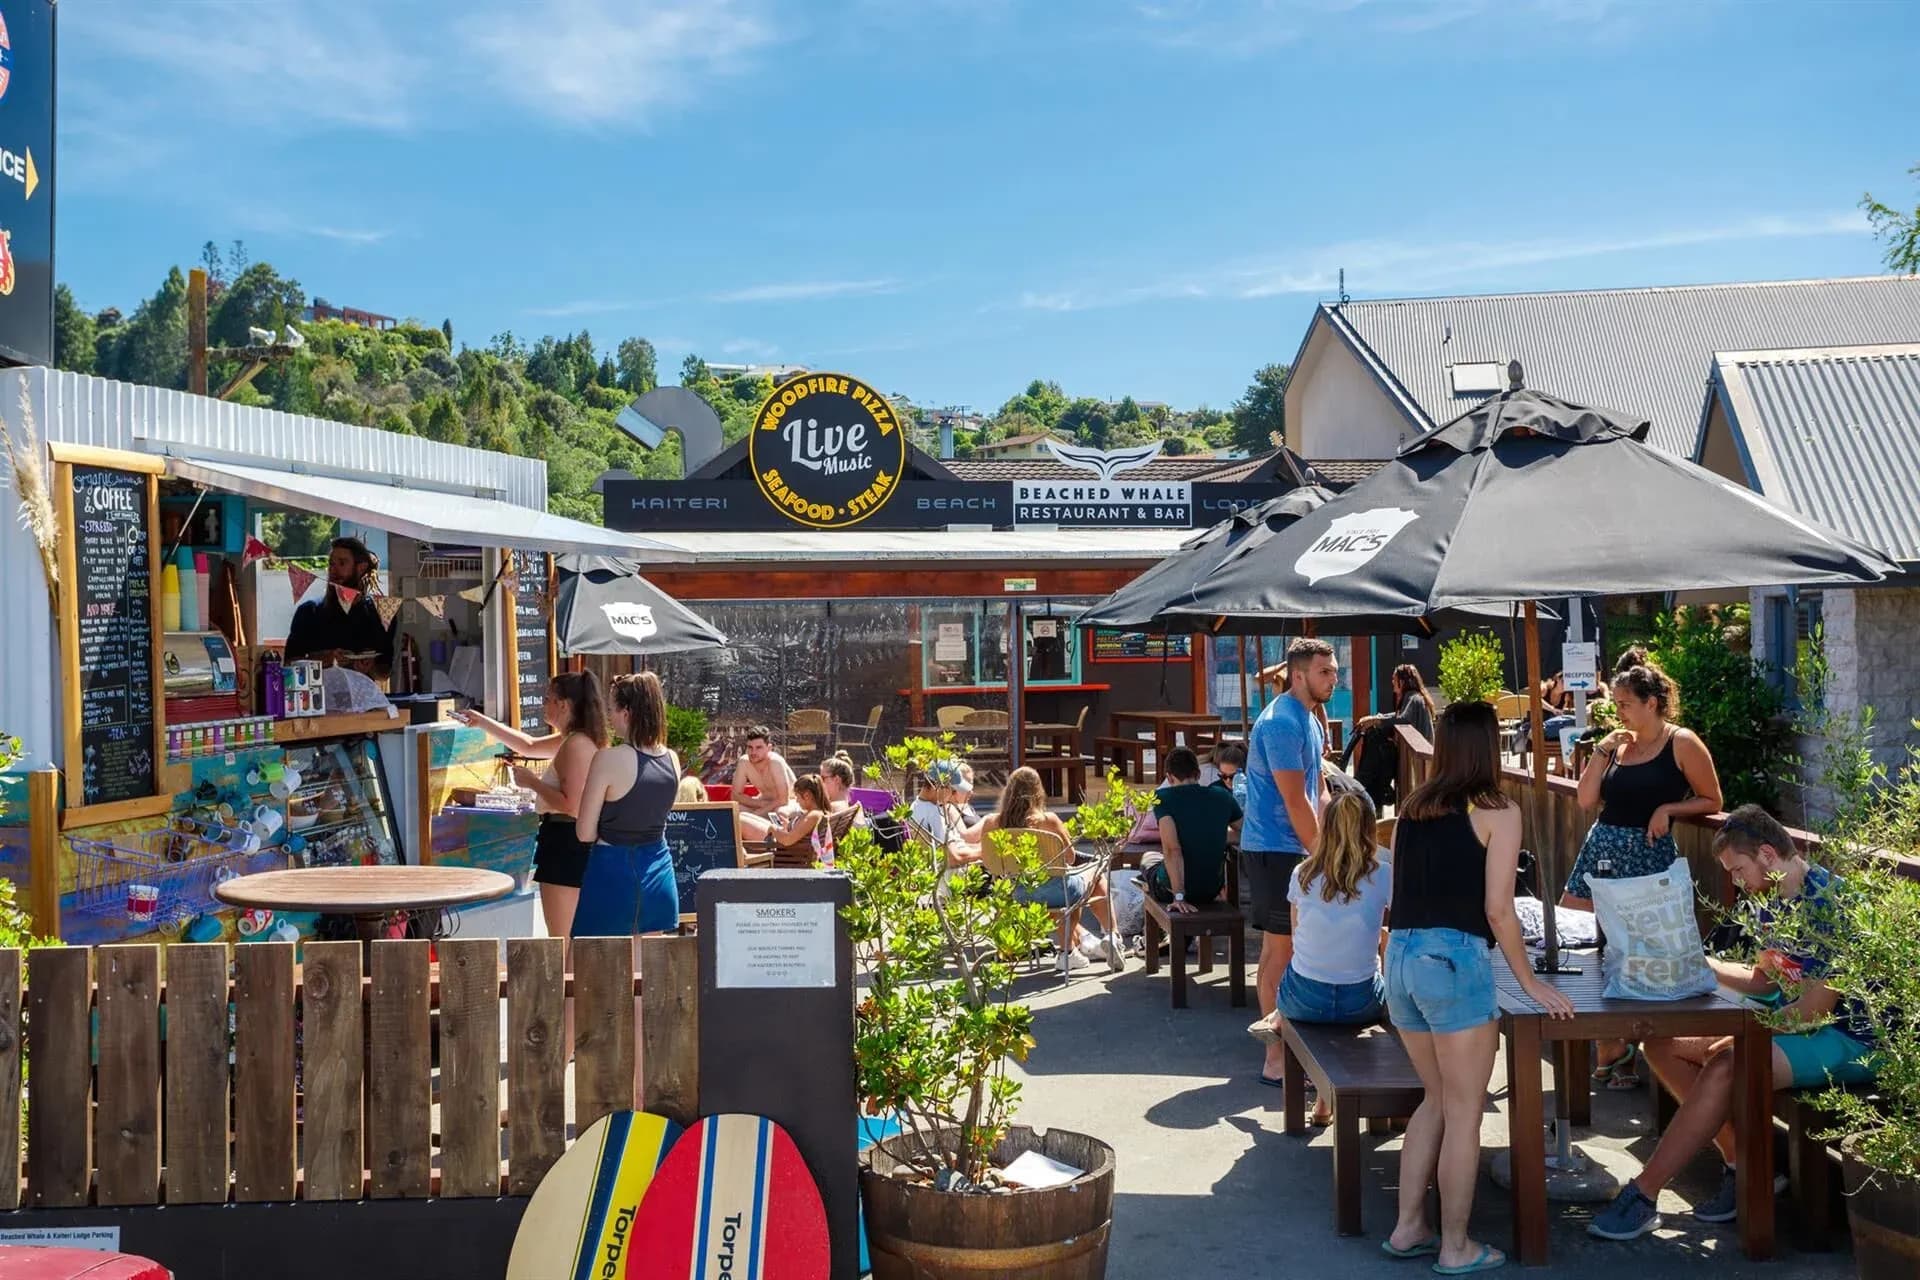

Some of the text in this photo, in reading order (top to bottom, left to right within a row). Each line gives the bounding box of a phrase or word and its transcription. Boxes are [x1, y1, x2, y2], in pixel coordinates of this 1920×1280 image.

[0, 147, 25, 183] CE
[761, 377, 894, 437] WOODFIRE PIZZA
[783, 418, 869, 470] Live
[823, 453, 873, 476] Music
[72, 472, 113, 495] Organic
[762, 469, 893, 521] SEAFOOD STEAK
[1020, 487, 1185, 500] BEACHED WHALE
[93, 486, 133, 511] COFFEE
[632, 498, 728, 509] KAITERI
[917, 498, 996, 510] BEACH
[1020, 507, 1185, 519] RESTAURANT & BAR
[84, 520, 113, 534] ESPRESSO
[1312, 534, 1388, 553] MAC'S
[610, 615, 652, 626] MAC'S
[756, 908, 796, 917] SMOKERS
[1621, 904, 1697, 933] reus
[1628, 928, 1700, 957] reus
[1628, 954, 1702, 982] reus
[27, 1232, 45, 1240] Whale
[73, 1231, 90, 1240] Lodge
[91, 1231, 114, 1239] Parking
[602, 1205, 637, 1280] Torpe
